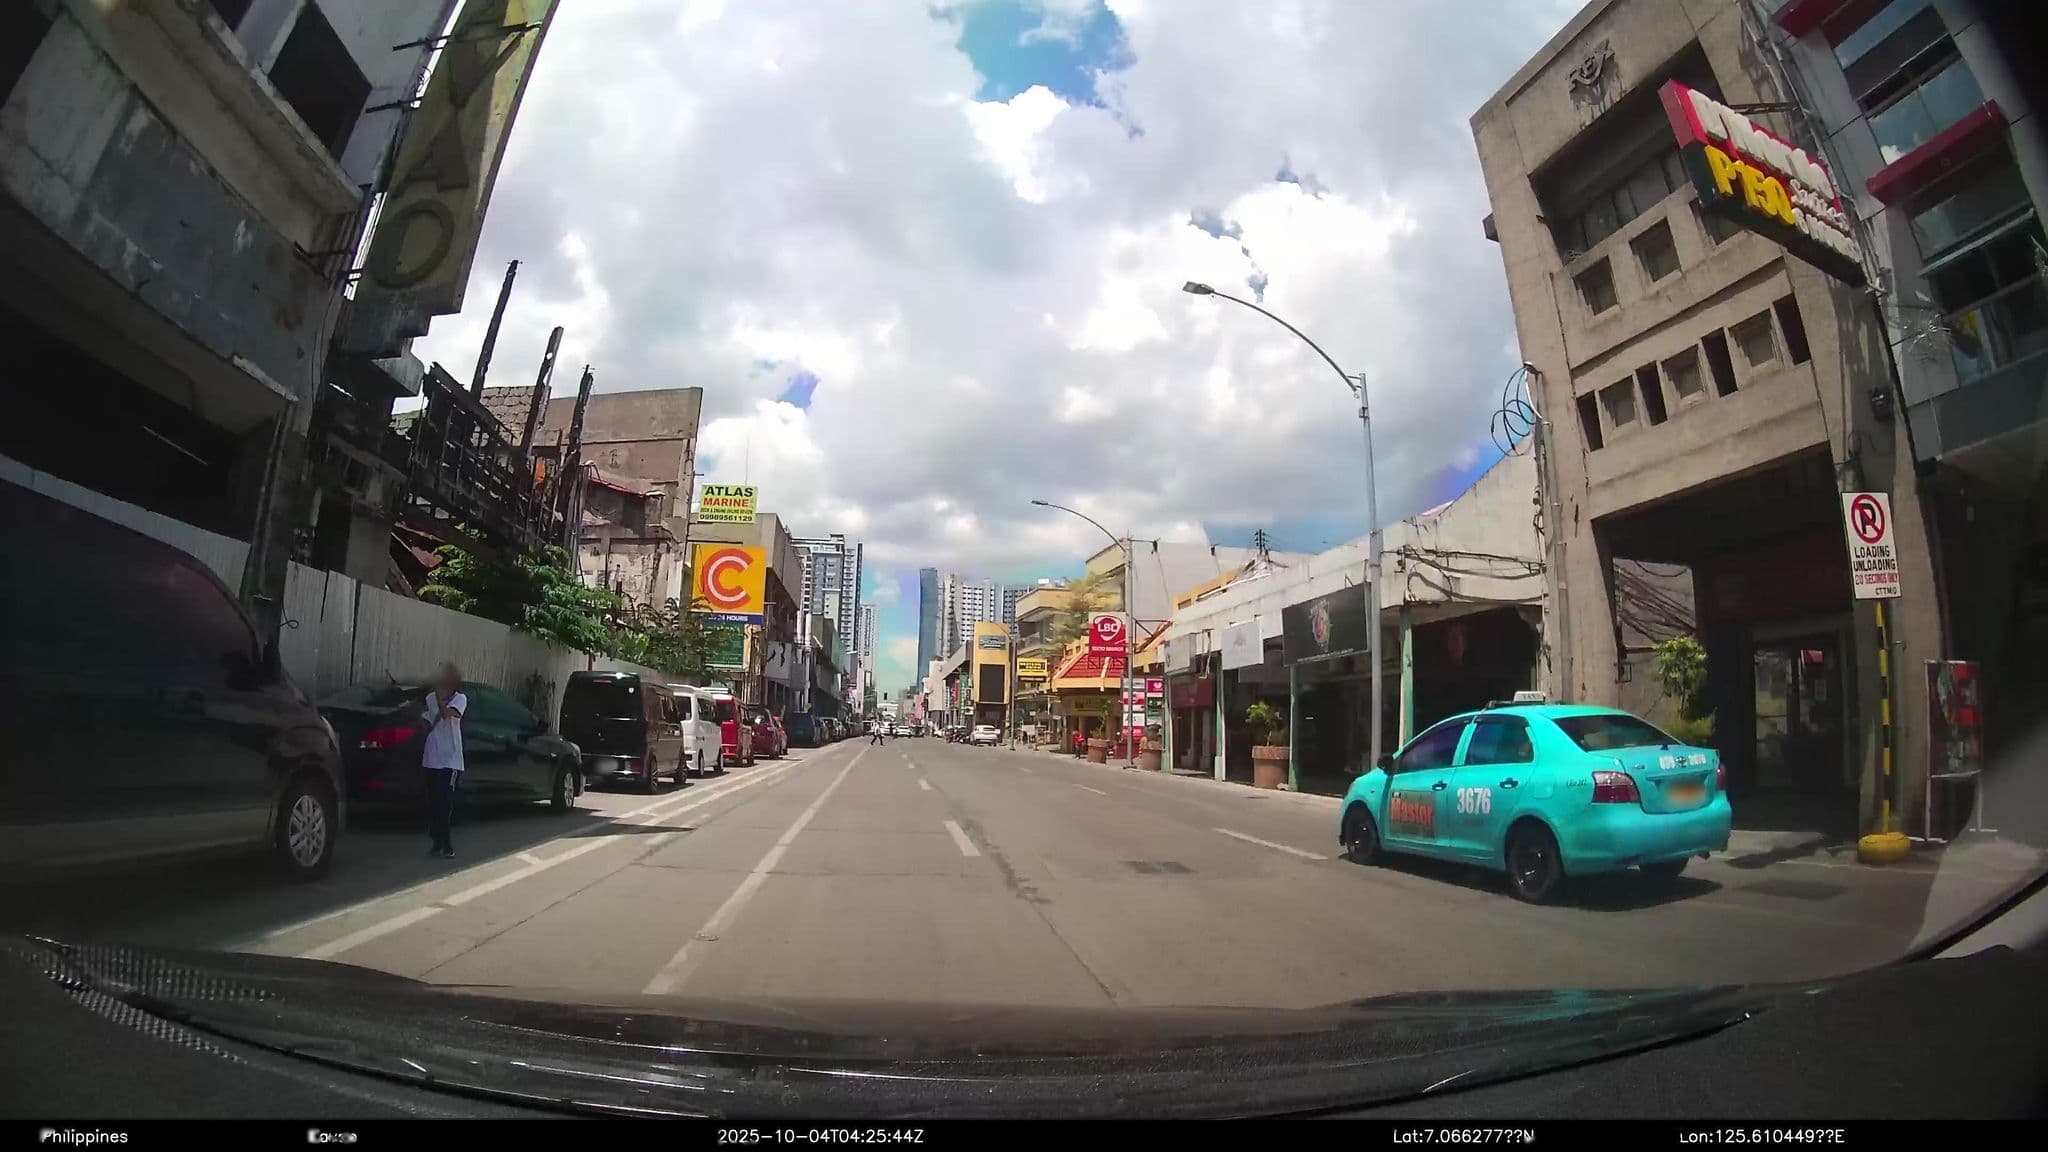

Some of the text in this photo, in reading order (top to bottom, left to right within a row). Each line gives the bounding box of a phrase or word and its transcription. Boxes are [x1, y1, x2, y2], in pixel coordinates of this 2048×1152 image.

[705, 486, 753, 497] ATLAS
[703, 498, 750, 508] MARINE
[1854, 545, 1890, 559] LOADING
[1853, 558, 1896, 572] UNLOADING
[1097, 623, 1119, 633] LBC
[1456, 788, 1492, 815] 3676
